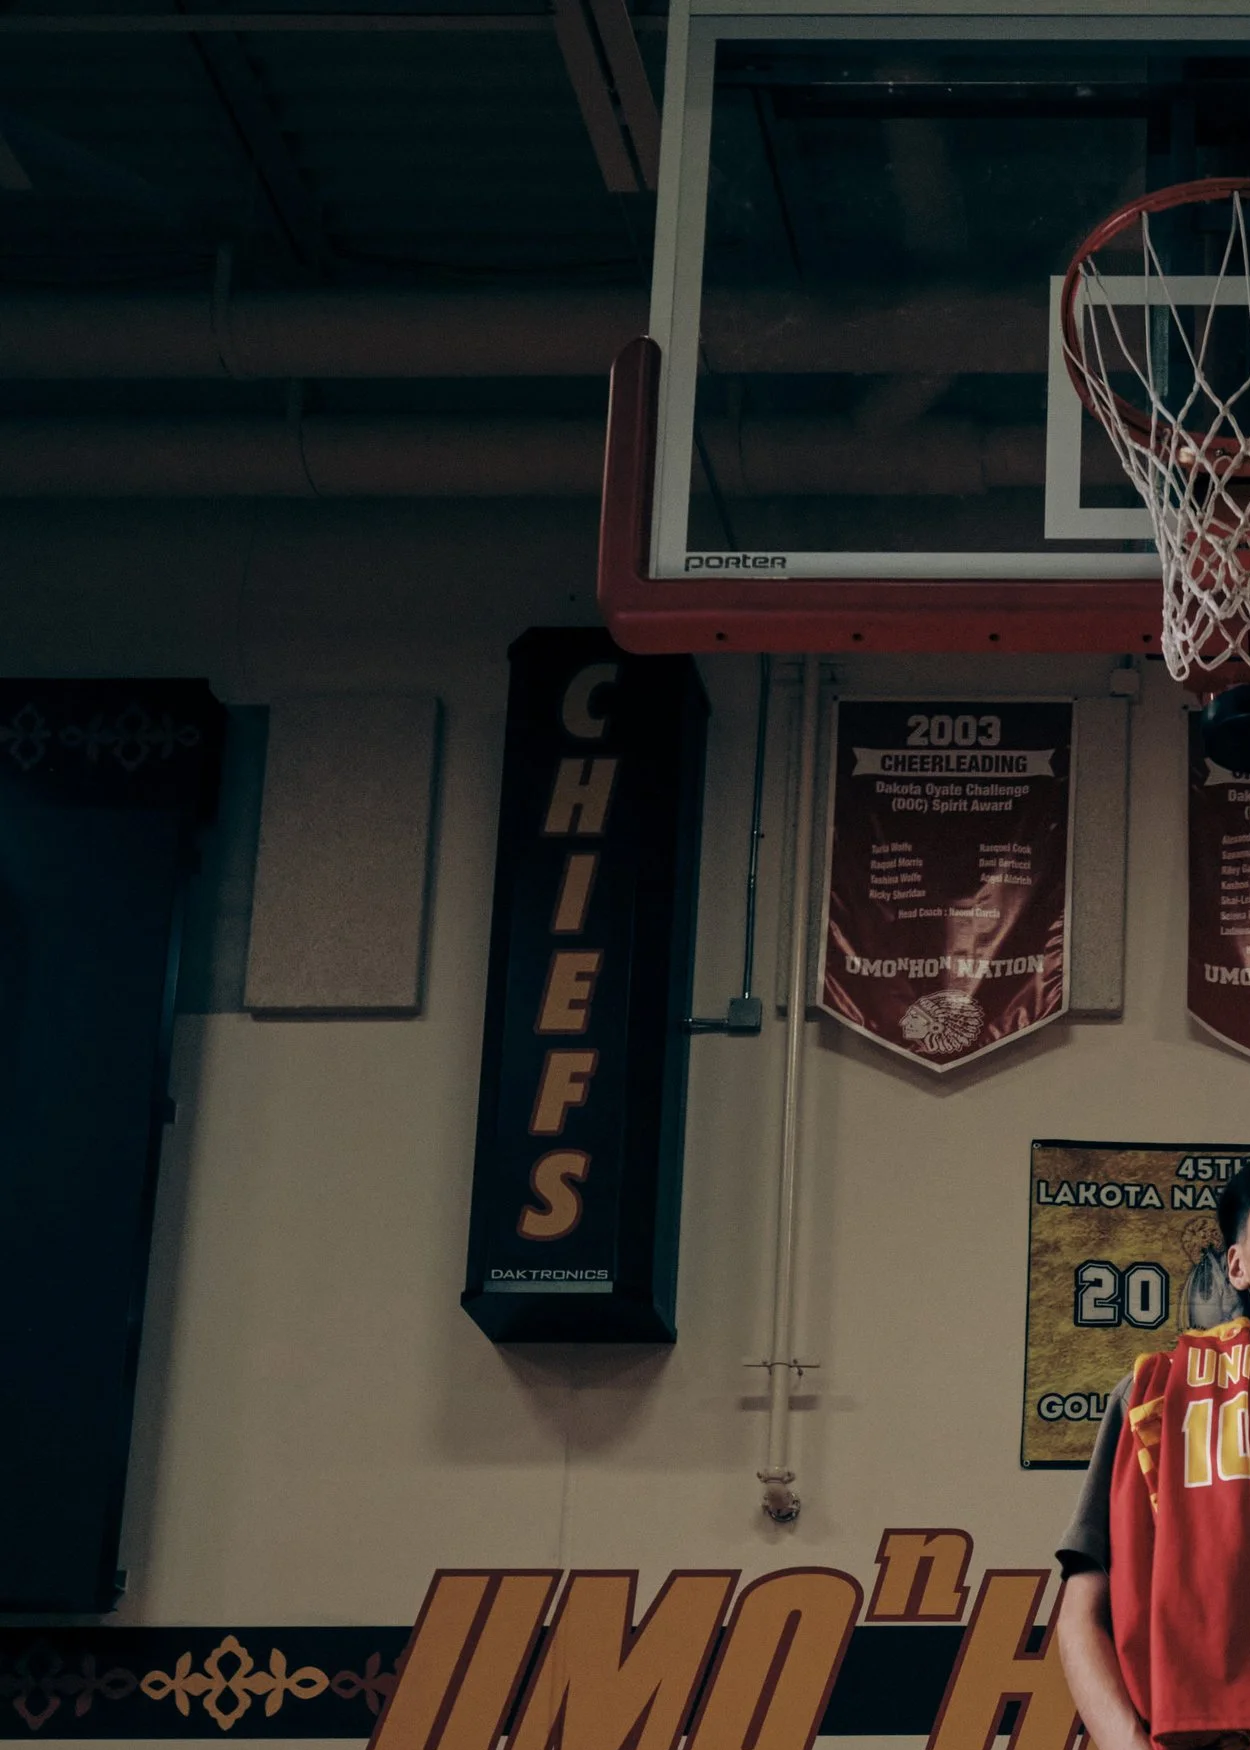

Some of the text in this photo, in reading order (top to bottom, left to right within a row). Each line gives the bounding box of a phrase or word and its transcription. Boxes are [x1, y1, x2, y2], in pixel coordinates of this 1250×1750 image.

[906, 714, 1001, 746] 2003
[880, 754, 1028, 773] CHEERLEADING
[875, 780, 1030, 798] Dakota Oyate Challenge
[932, 799, 968, 814] Spirit
[969, 799, 1013, 812] Award
[898, 857, 923, 867] Morris
[892, 888, 926, 900] Sheridan
[898, 909, 917, 919] Head
[919, 907, 943, 918] Coach
[516, 663, 622, 1242] CHIEFS
[956, 953, 1045, 979] NATION
[1037, 1180, 1165, 1210] LAKOTA
[490, 1268, 609, 1281] DAKTRONICS
[1075, 1259, 1169, 1329] 20
[1037, 1393, 1110, 1422] GOL
